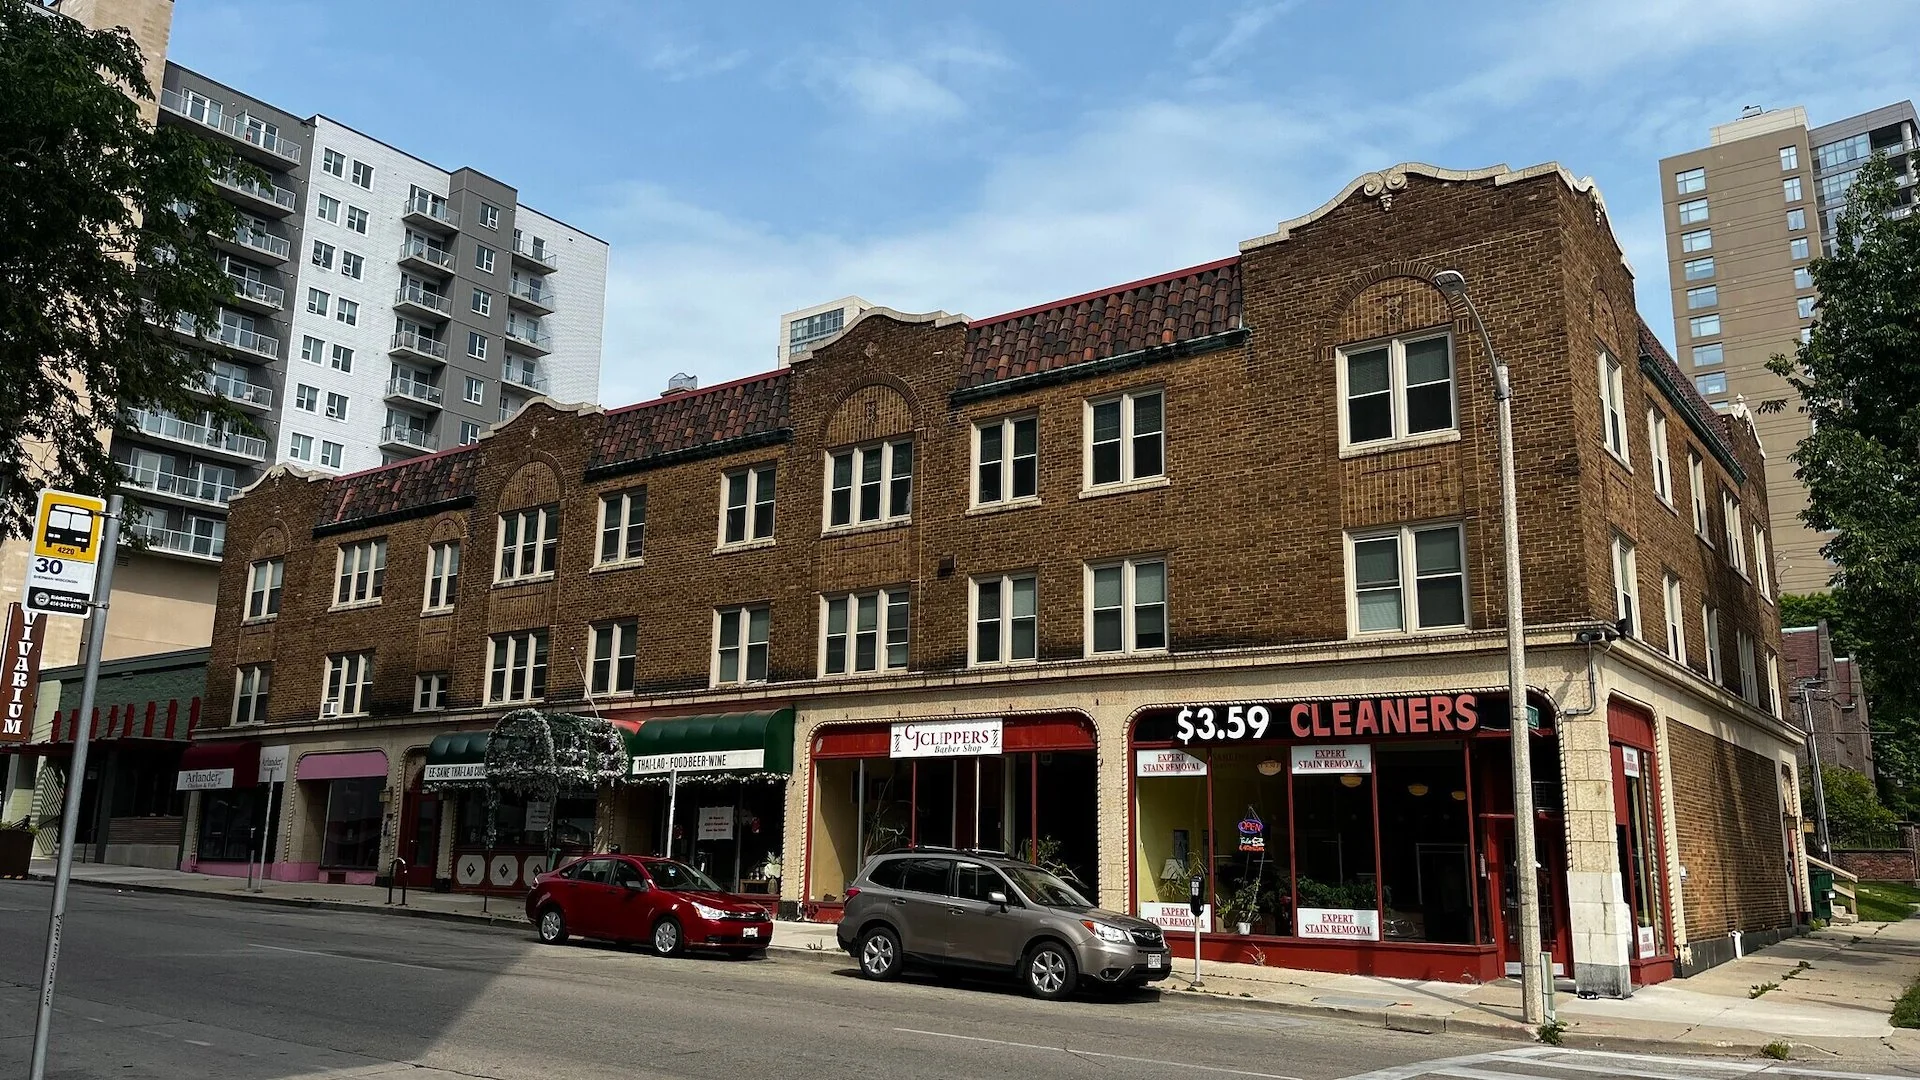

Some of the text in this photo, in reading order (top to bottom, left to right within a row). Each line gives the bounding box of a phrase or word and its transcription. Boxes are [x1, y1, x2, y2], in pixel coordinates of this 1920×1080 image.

[57, 547, 75, 555] 4220
[34, 557, 63, 575] 30
[2, 611, 38, 734] VIVARIUM
[1176, 694, 1477, 745] $3.59 CLEANERS
[934, 744, 982, 753] Barber Shop
[1157, 753, 1185, 762] EXPERT
[1315, 750, 1347, 758] EXPERT
[1143, 763, 1201, 772] STAIN REMOVAL
[1298, 759, 1365, 769] STAIN REMOVAL
[1240, 821, 1261, 832] OPEN
[1161, 907, 1189, 917] EXPERT
[1169, 918, 1205, 928] REMOVL
[1322, 914, 1354, 923] EXPERT
[1305, 924, 1372, 935] STAIN REMOVAL
